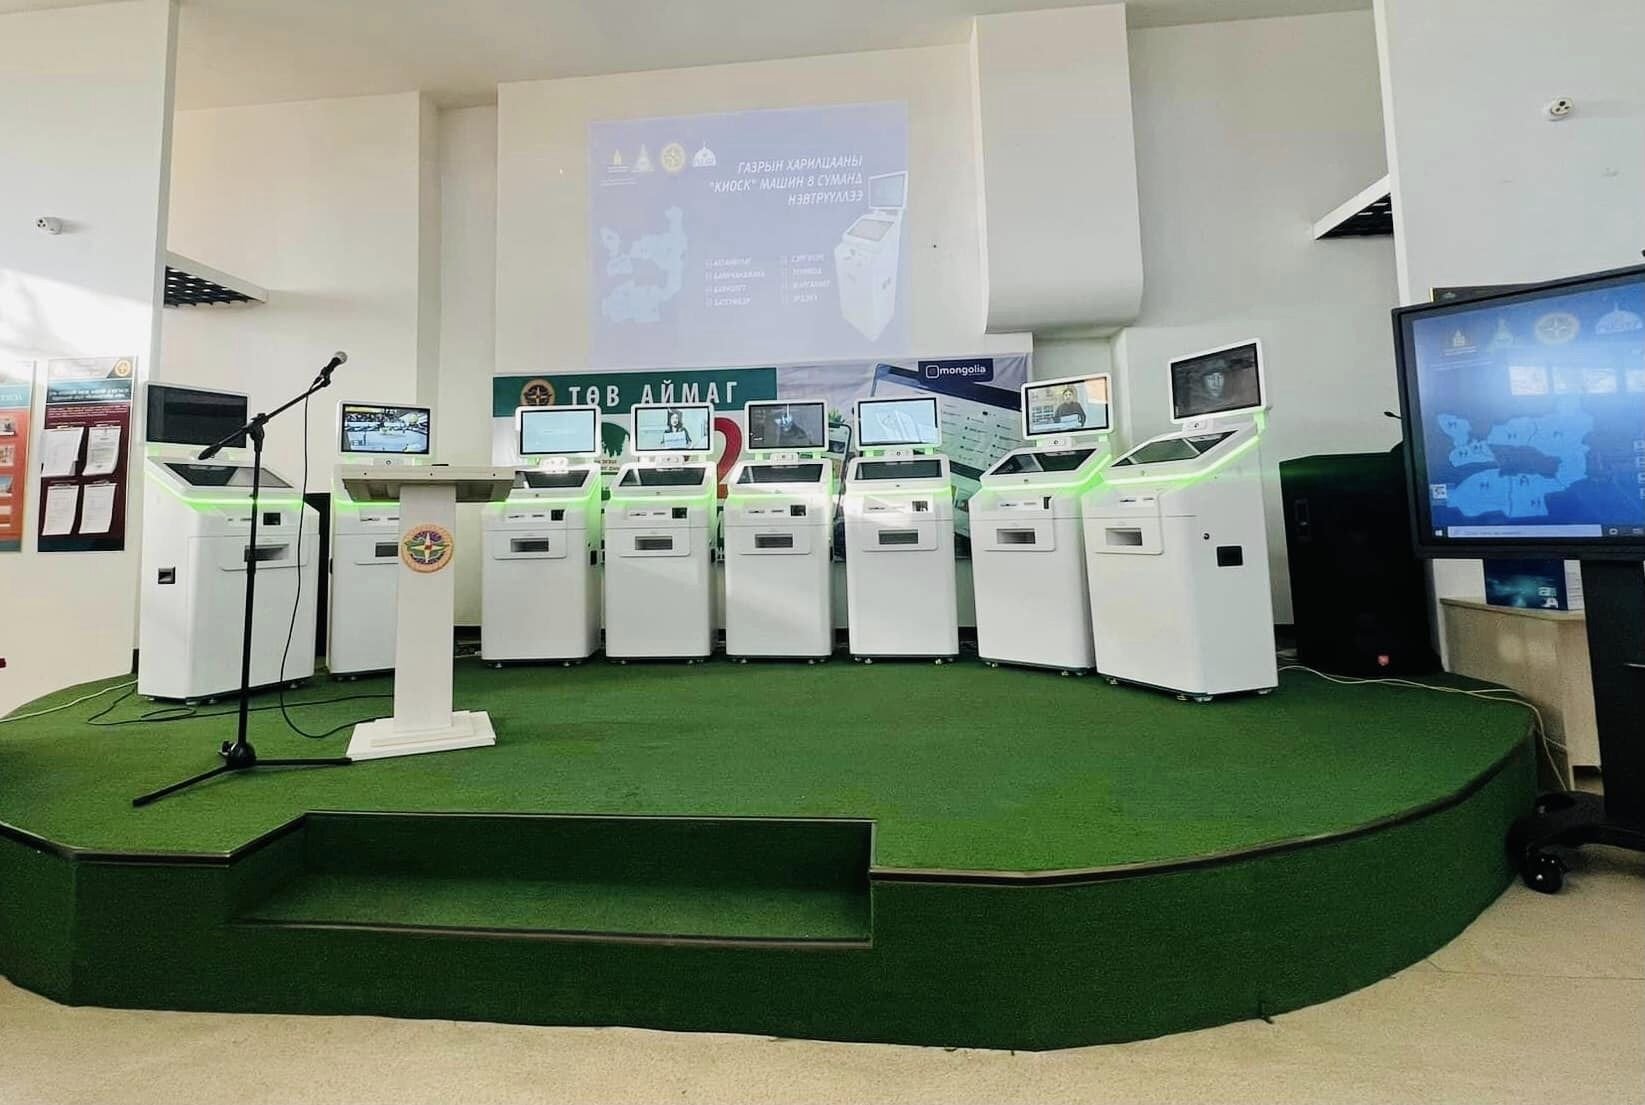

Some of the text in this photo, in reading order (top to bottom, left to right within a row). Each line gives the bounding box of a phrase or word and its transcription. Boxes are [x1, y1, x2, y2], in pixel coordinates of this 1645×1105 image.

[737, 154, 864, 174] ГАЗРЫН ХАРИЛЦААНЫ
[760, 177, 804, 190] МАШИН
[818, 173, 863, 187] СУМАНД
[939, 364, 986, 377] mongolia
[568, 378, 738, 406] ТӨВ АЙМАГ
